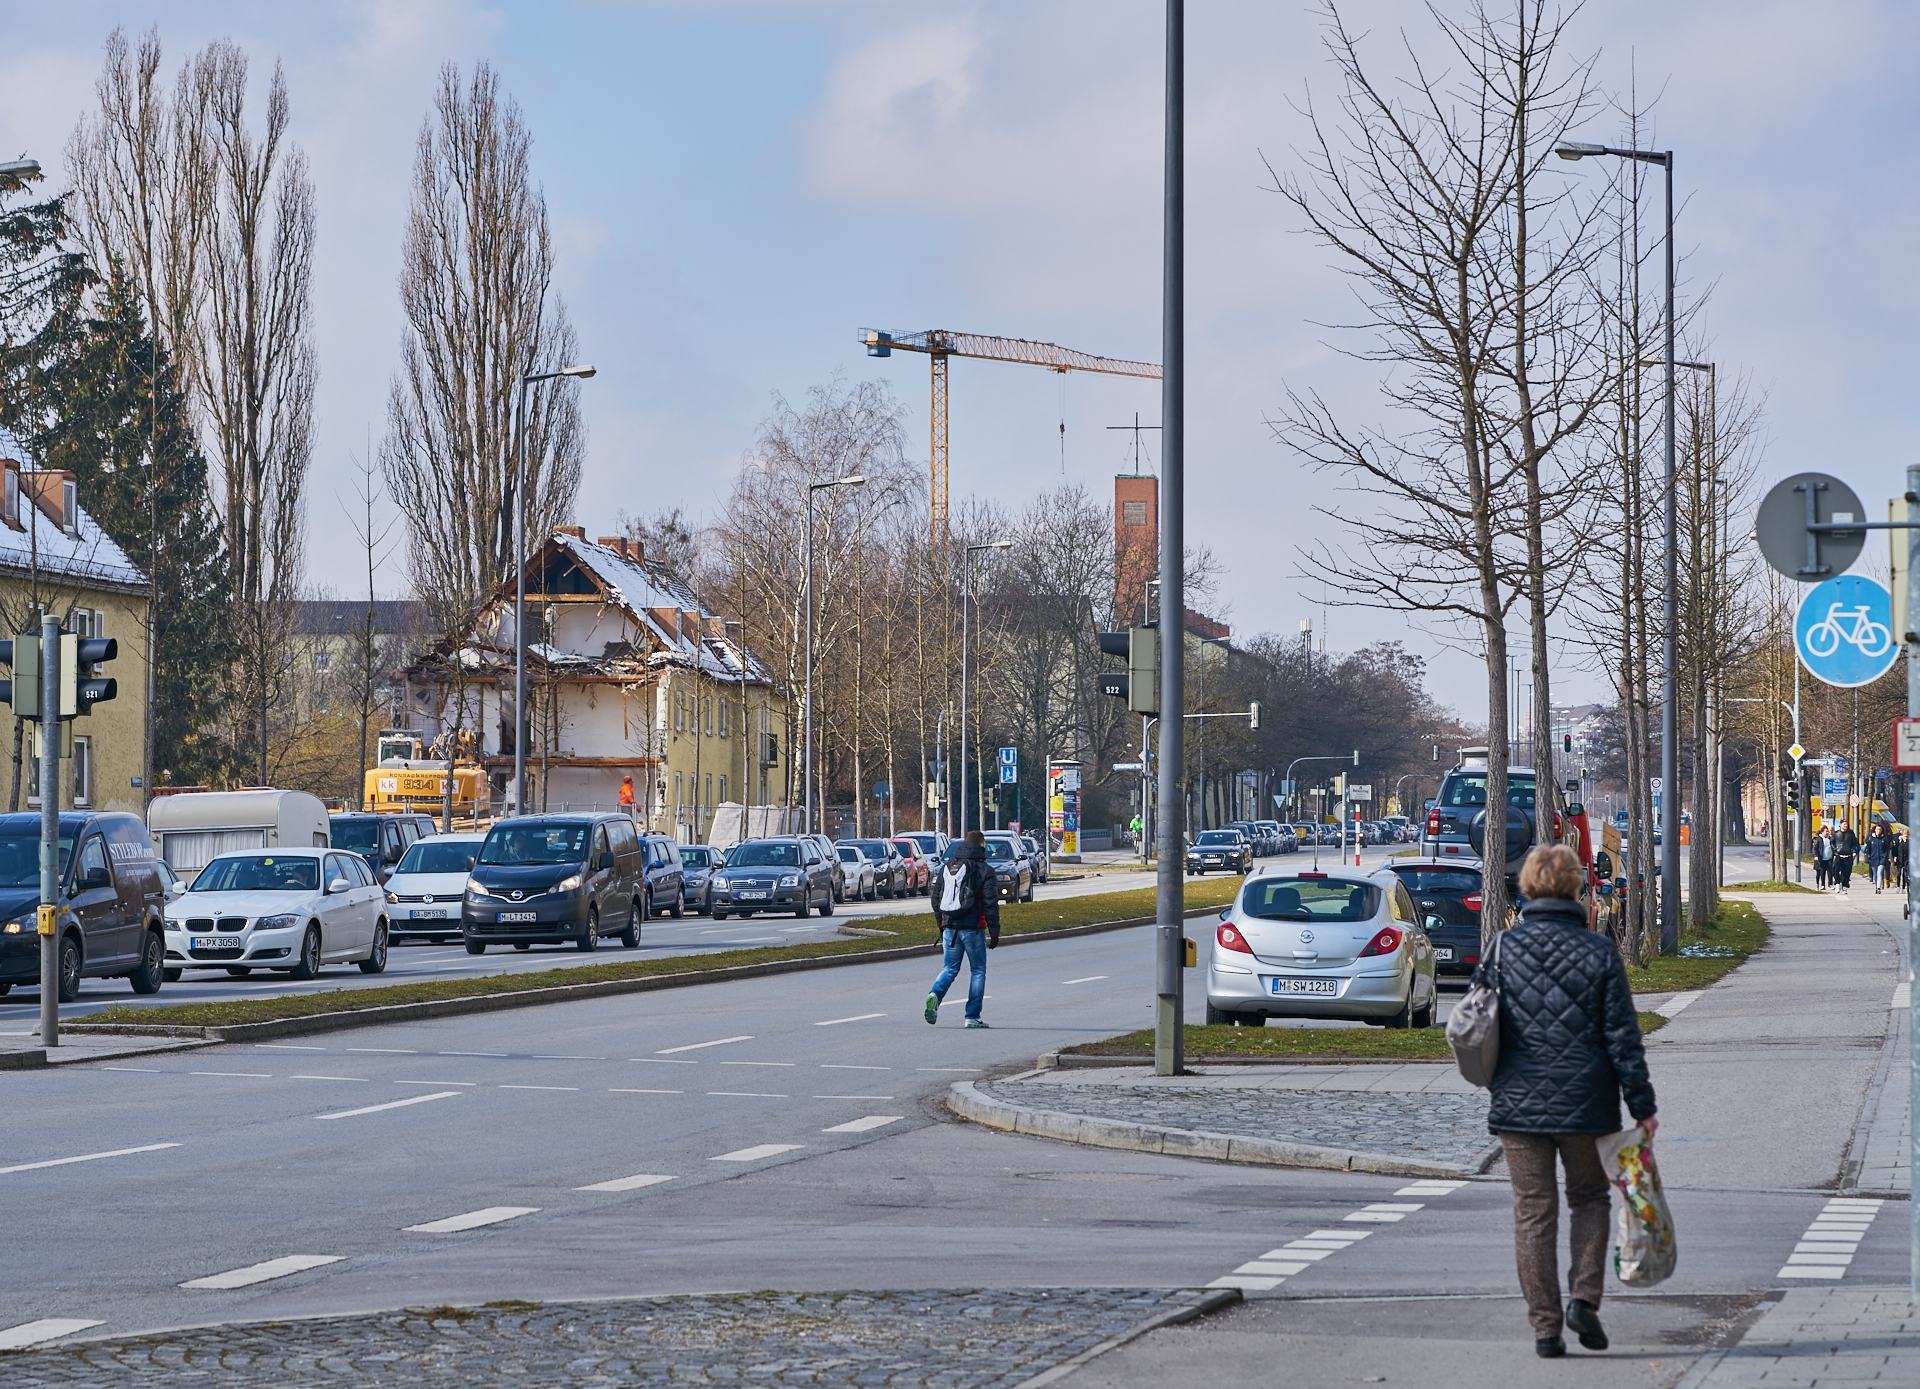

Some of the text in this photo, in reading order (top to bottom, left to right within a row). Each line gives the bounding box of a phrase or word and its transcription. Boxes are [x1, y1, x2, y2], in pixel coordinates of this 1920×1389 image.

[85, 690, 98, 699] 521
[1105, 686, 1120, 694] 522
[403, 778, 434, 790] 934
[218, 938, 238, 947] 3058
[1309, 982, 1335, 992] 1218
